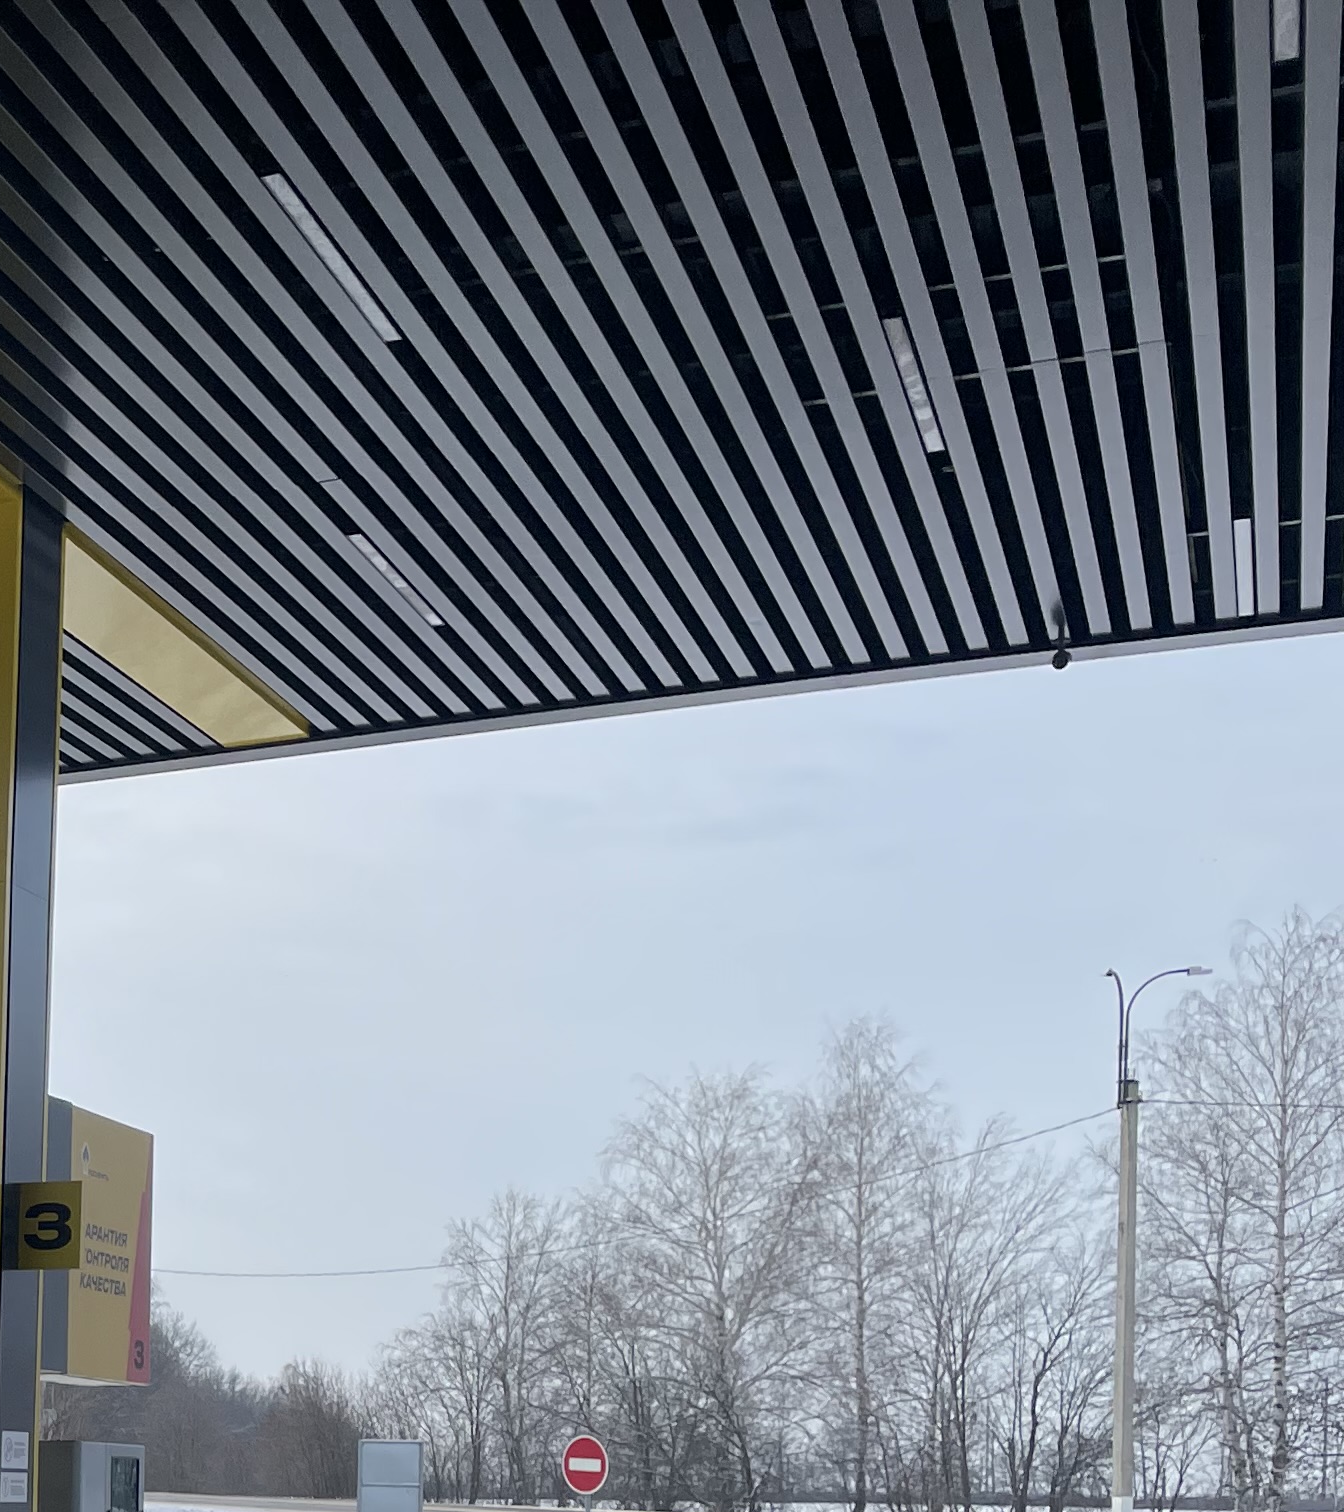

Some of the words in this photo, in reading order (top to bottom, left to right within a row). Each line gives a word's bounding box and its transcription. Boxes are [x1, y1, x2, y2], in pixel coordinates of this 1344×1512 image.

[24, 1202, 72, 1250] 3
[85, 1223, 128, 1248] АРАНТИЯ
[85, 1248, 129, 1274] ОНТРОЛЯ
[80, 1272, 127, 1297] КАЧЕСТВА
[133, 1339, 145, 1370] 3
